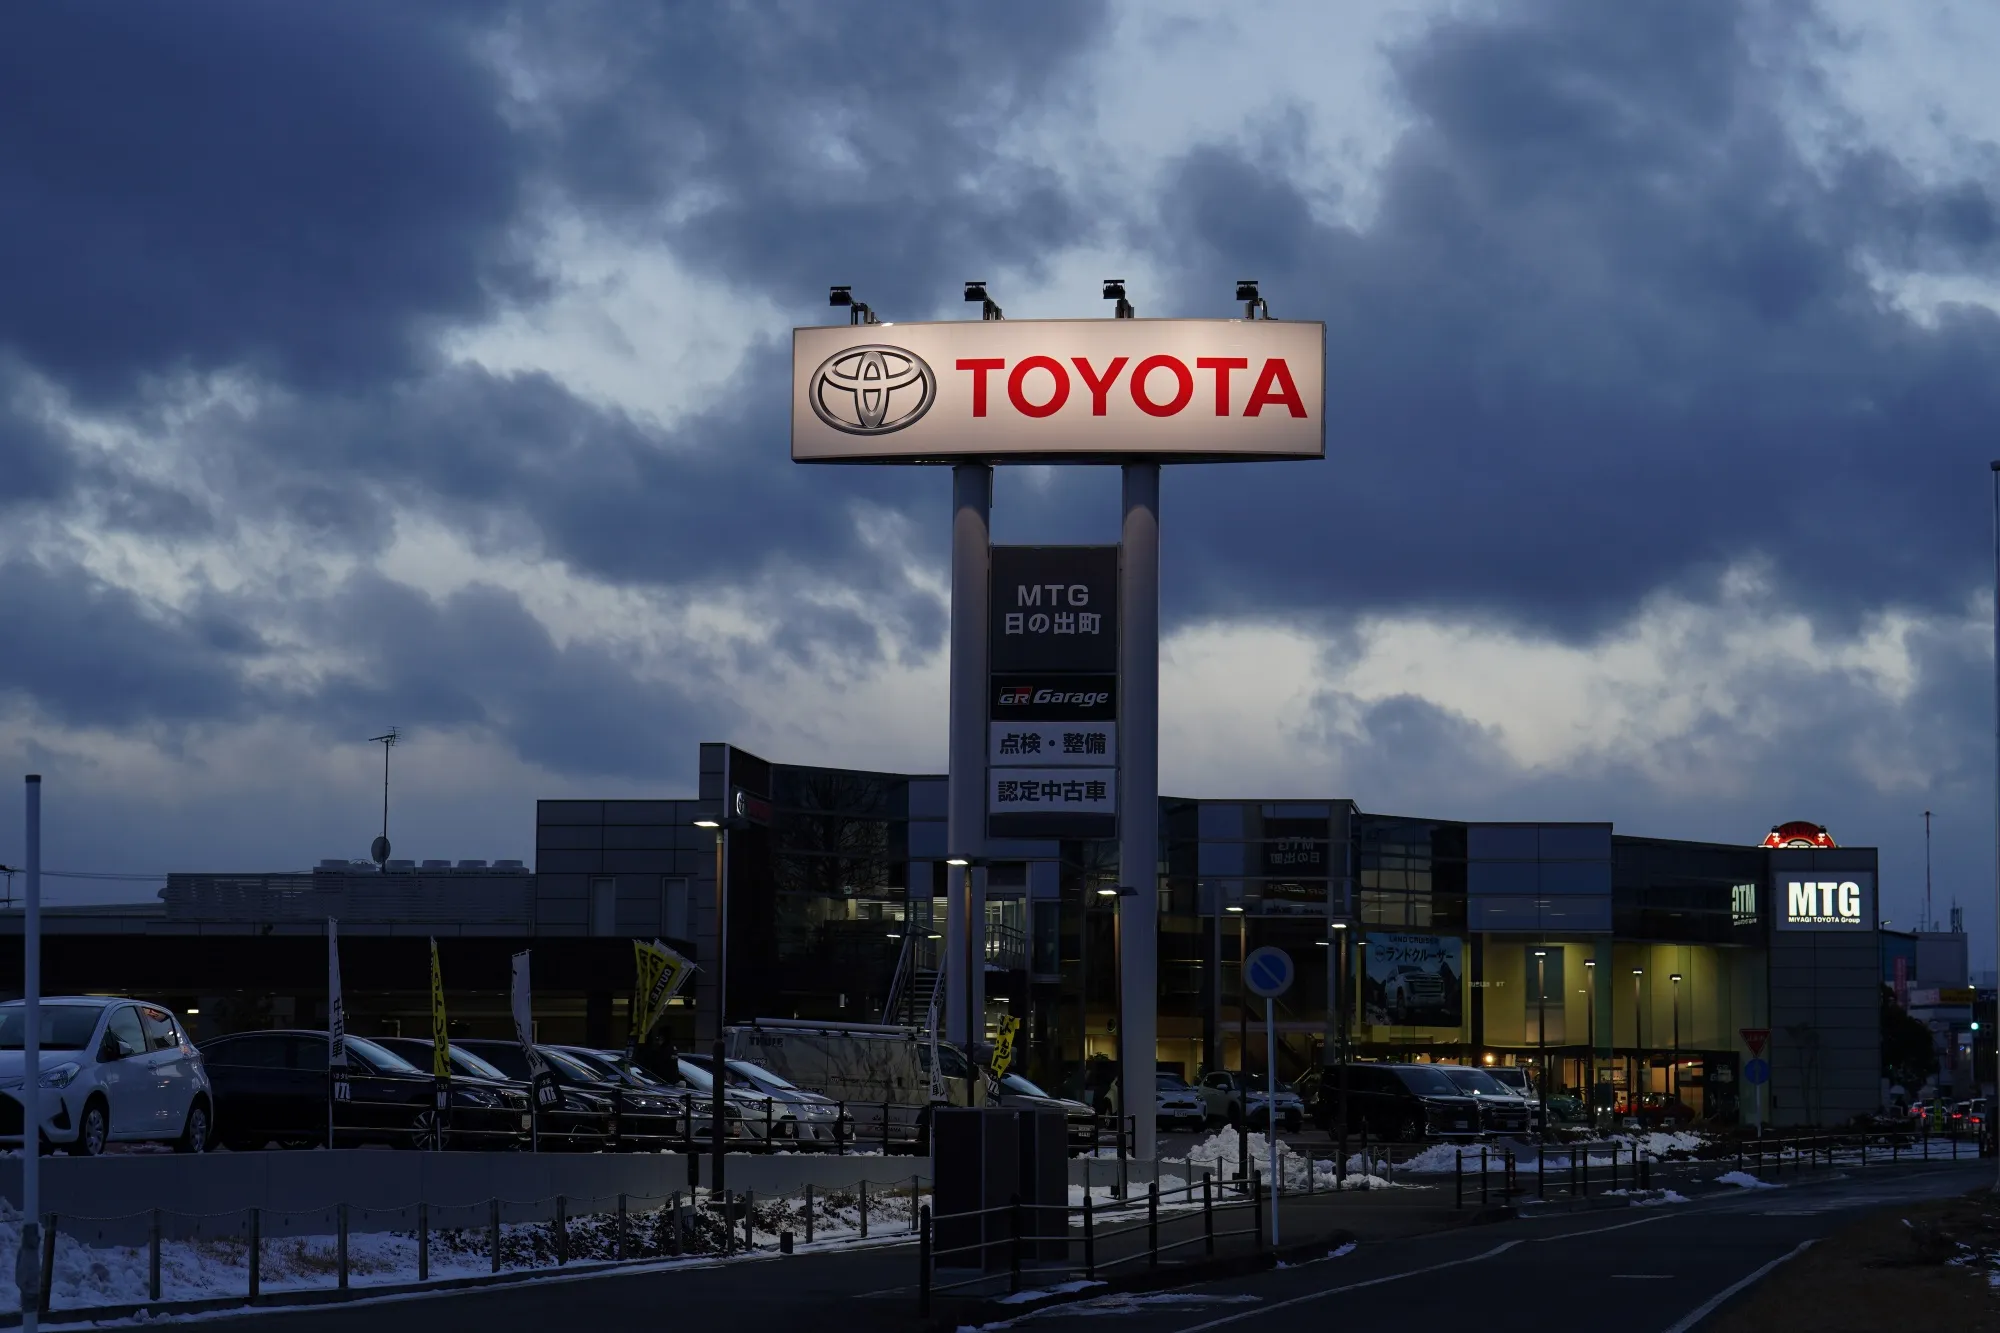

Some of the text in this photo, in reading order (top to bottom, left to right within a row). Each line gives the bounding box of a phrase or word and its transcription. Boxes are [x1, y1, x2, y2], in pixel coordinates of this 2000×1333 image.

[956, 354, 1308, 418] TOYOTA
[1017, 584, 1089, 607] MTG
[1005, 612, 1102, 635] 日の出町
[999, 689, 1109, 707] GR Garage
[999, 733, 1107, 755] 点検・整備
[998, 780, 1107, 802] 認定中古車
[1788, 881, 1861, 917] MTG
[1841, 916, 1861, 924] Group
[1389, 935, 1440, 944] LAND CRUISER
[1386, 946, 1454, 963] ランドクルーザー
